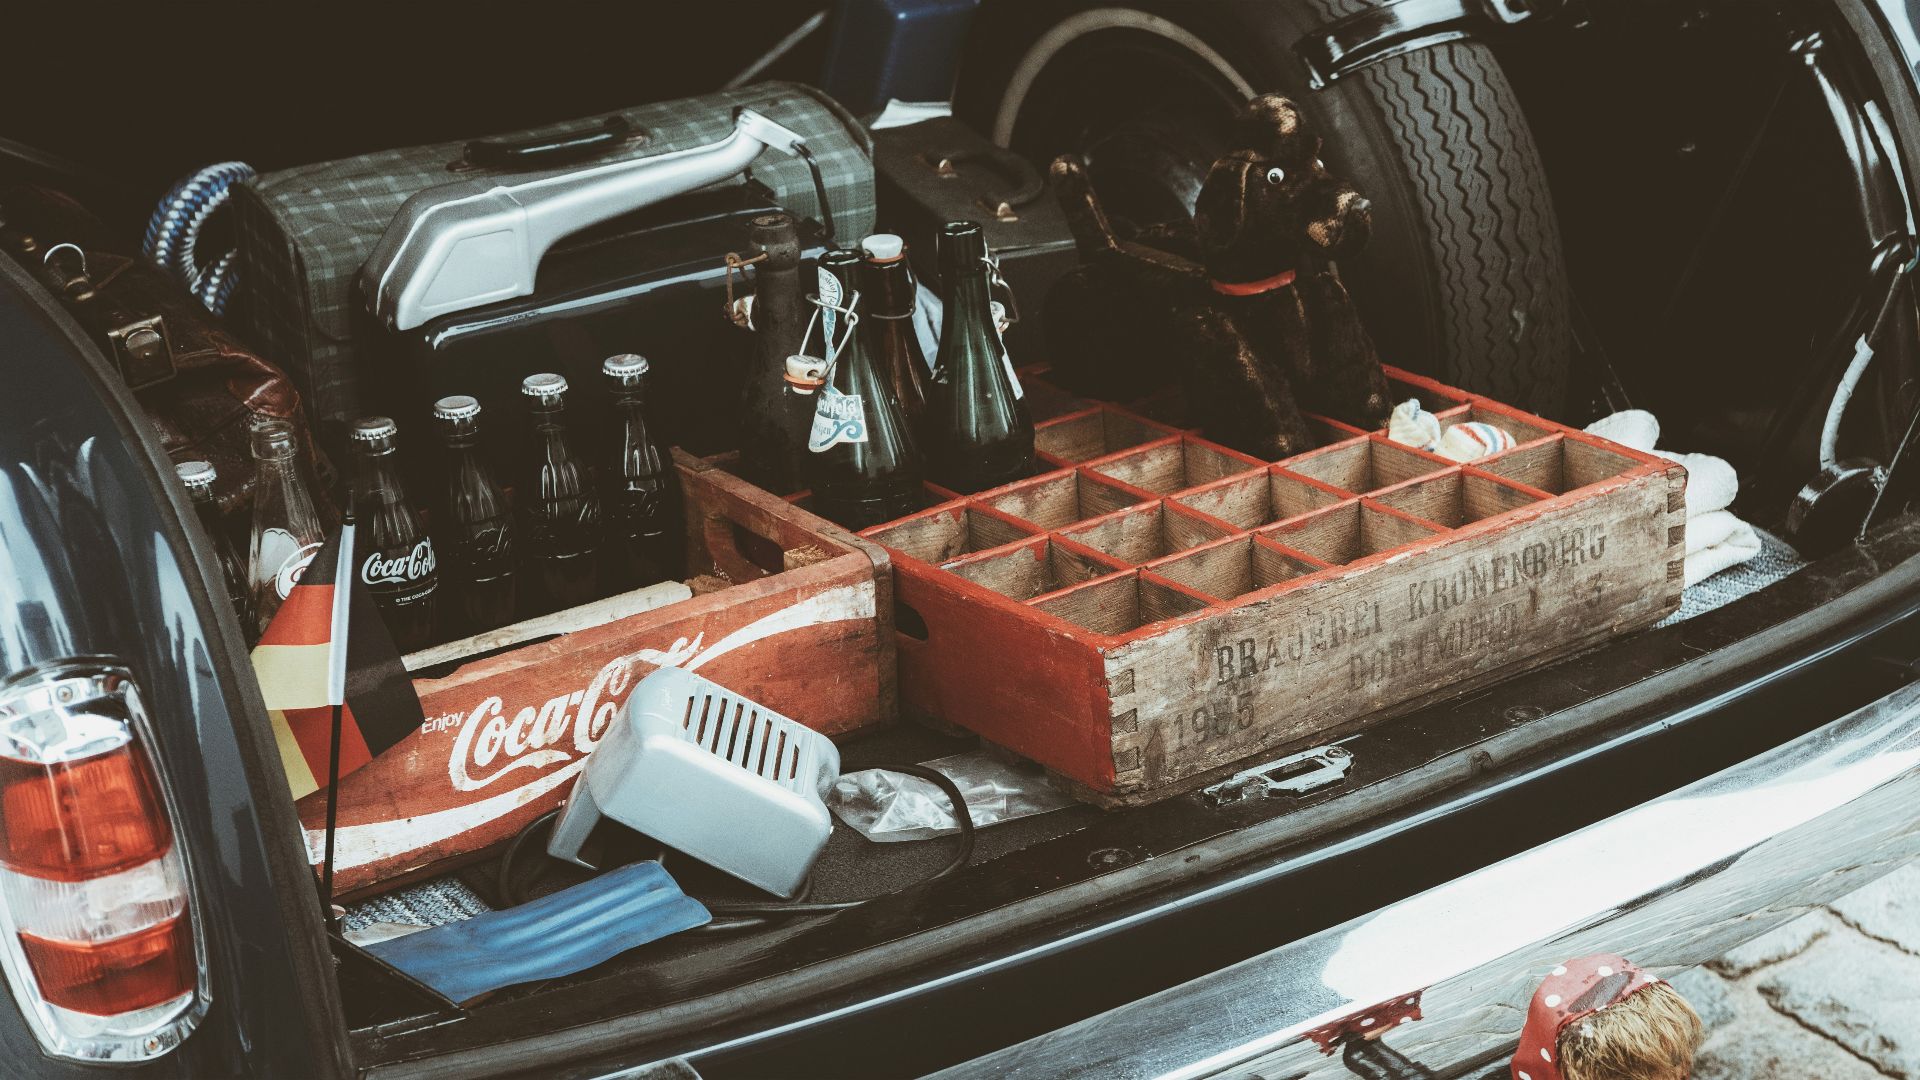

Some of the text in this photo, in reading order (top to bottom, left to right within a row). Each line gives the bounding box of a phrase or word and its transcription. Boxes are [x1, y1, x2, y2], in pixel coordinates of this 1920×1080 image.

[1215, 523, 1607, 686] BRAUEREI KRONENBURG
[421, 711, 465, 734] Enjoy
